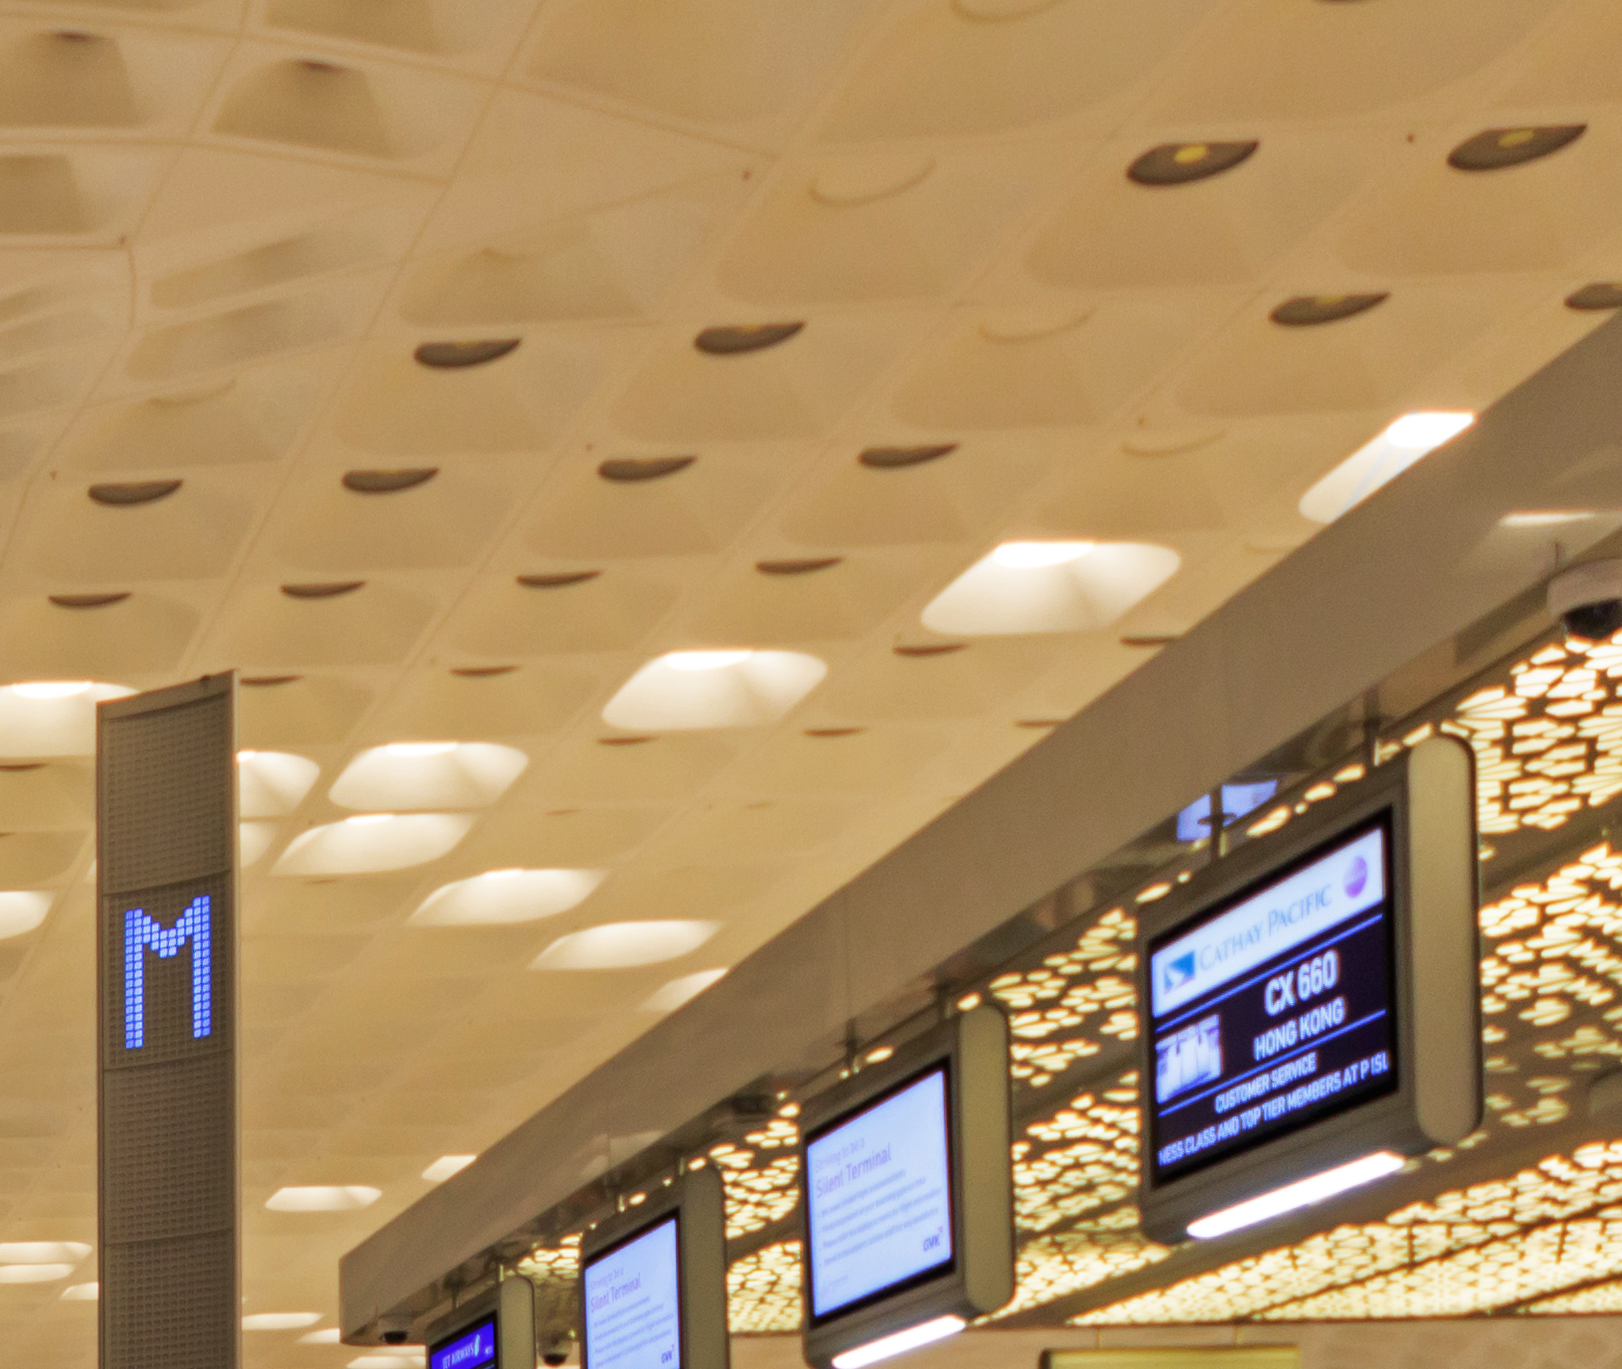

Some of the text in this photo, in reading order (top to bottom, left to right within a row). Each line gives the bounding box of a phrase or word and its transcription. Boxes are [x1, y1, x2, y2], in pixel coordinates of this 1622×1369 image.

[1200, 884, 1332, 970] CATHAY PACIFIC
[125, 895, 211, 1049] M
[1265, 950, 1338, 1016] CX 660
[1254, 997, 1345, 1061] HONG KONG
[1185, 1126, 1216, 1155] CLASS
[1217, 1115, 1240, 1141] AND
[1240, 1106, 1261, 1130] TOP
[1262, 1096, 1286, 1121] TIER
[1287, 1071, 1341, 1111] MEMBERS
[1343, 1063, 1358, 1087] AT
[1215, 1051, 1317, 1113] CUSTOMER SERVICE
[816, 1142, 892, 1198] Silent Terminal
[923, 1234, 940, 1252] GVK
[611, 1272, 641, 1302] Terminal
